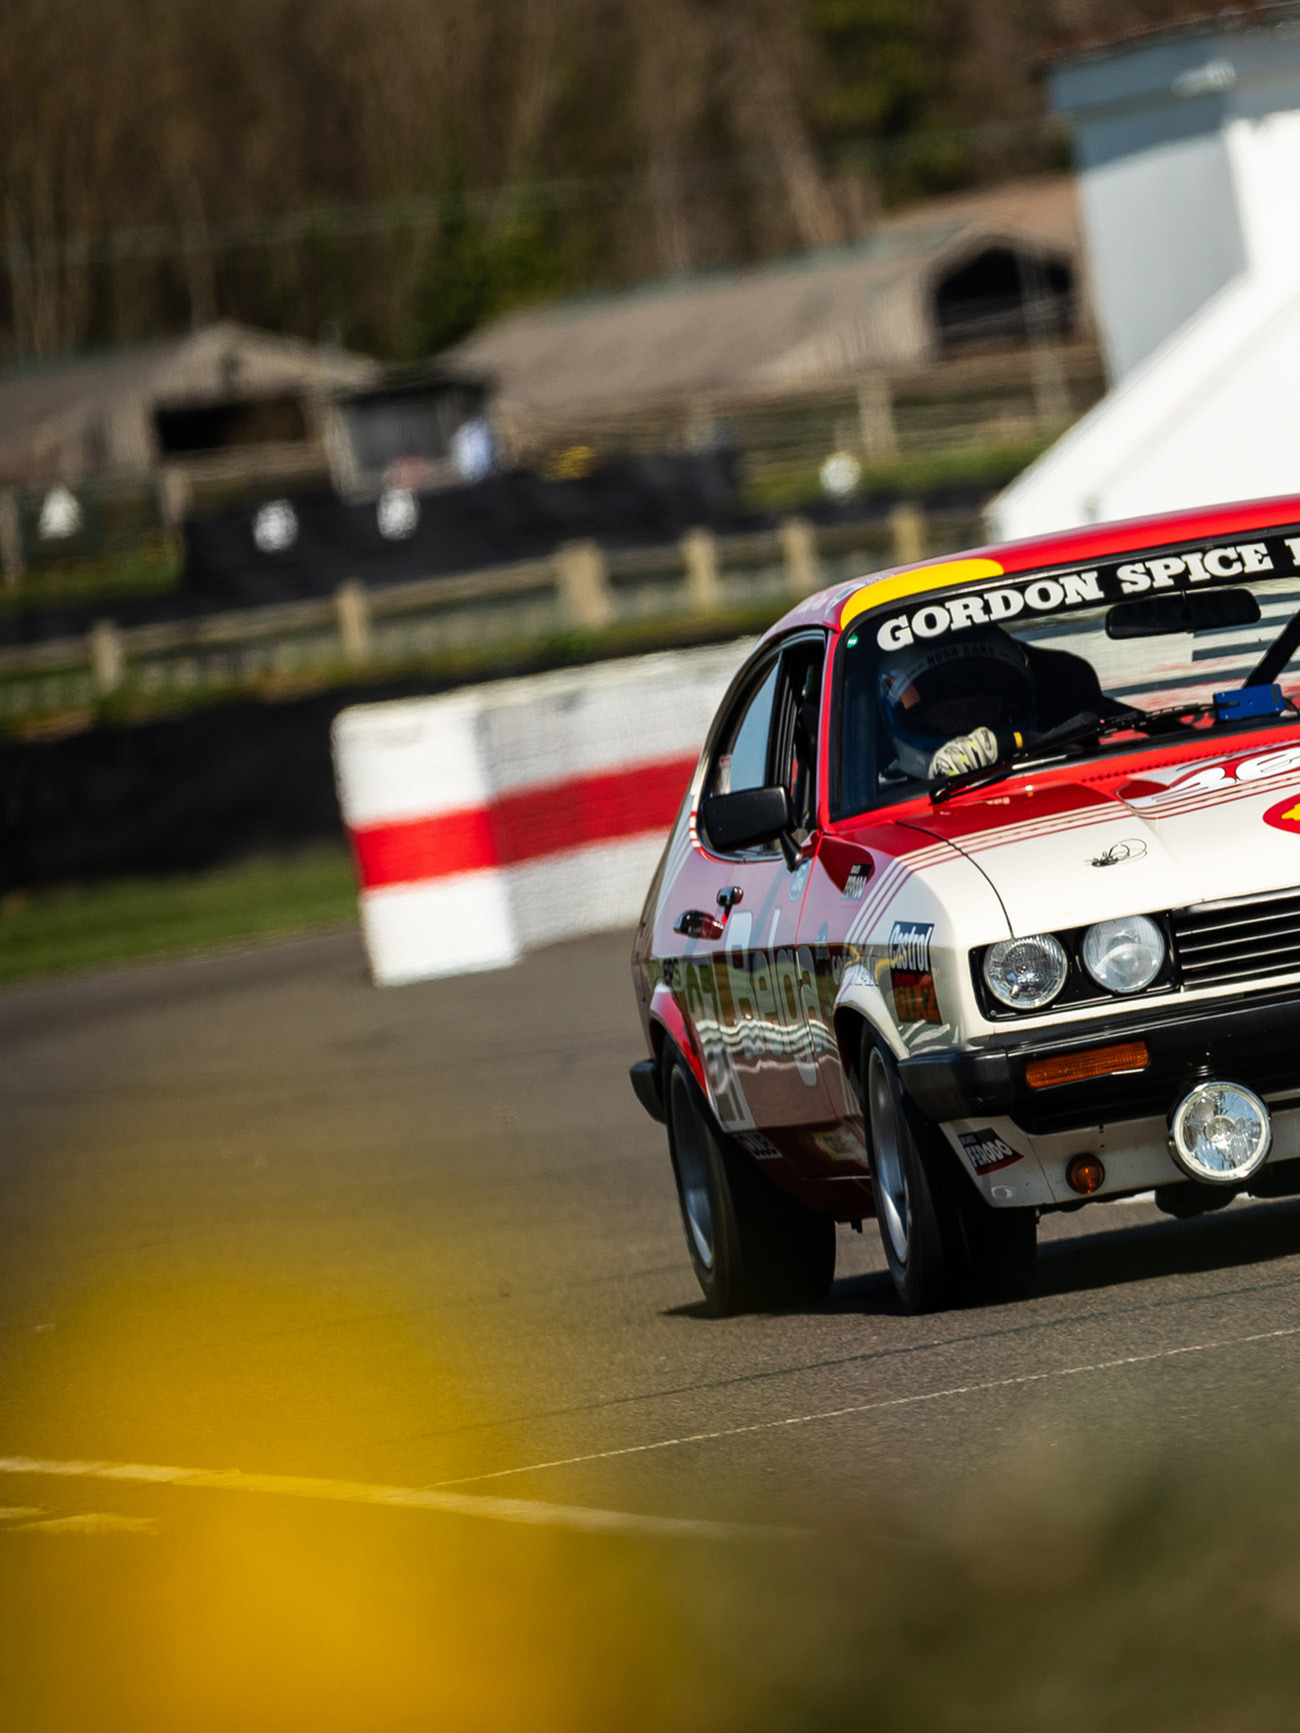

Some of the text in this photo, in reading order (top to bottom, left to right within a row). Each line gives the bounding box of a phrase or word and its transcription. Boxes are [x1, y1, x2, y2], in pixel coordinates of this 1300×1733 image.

[877, 571, 1104, 651] GORDON
[1117, 542, 1274, 594] SPICE
[889, 924, 933, 972] Castrol
[965, 1139, 1013, 1167] FERODO
